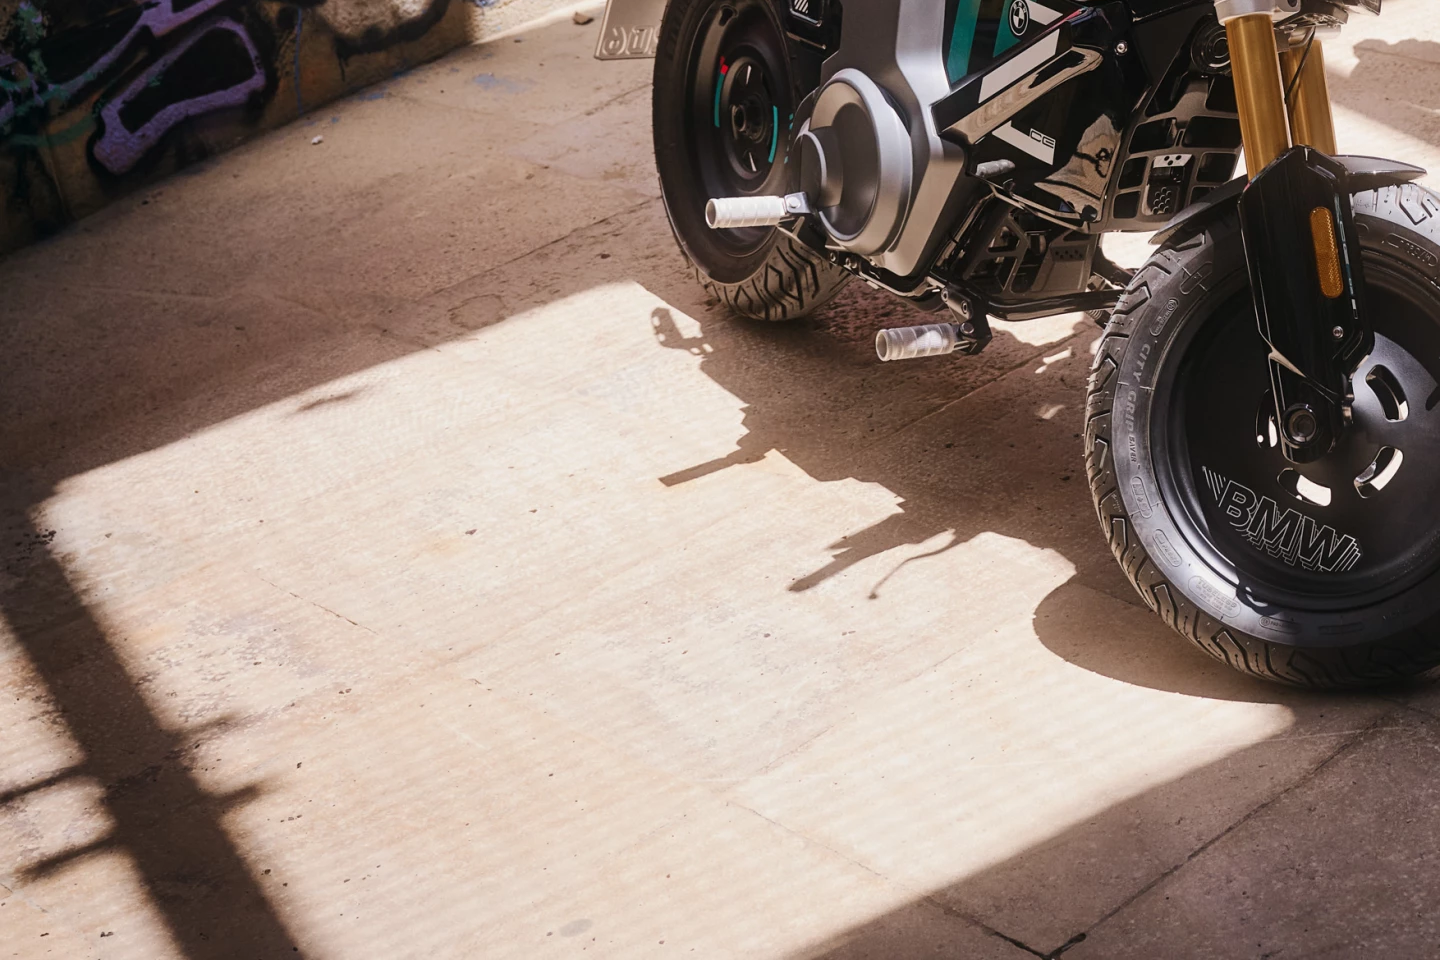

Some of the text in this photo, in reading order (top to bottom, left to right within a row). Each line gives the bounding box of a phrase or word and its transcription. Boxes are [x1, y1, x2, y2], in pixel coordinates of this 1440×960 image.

[1125, 342, 1151, 463] CITY GRIP SAVER
[1219, 480, 1360, 571] BMW
